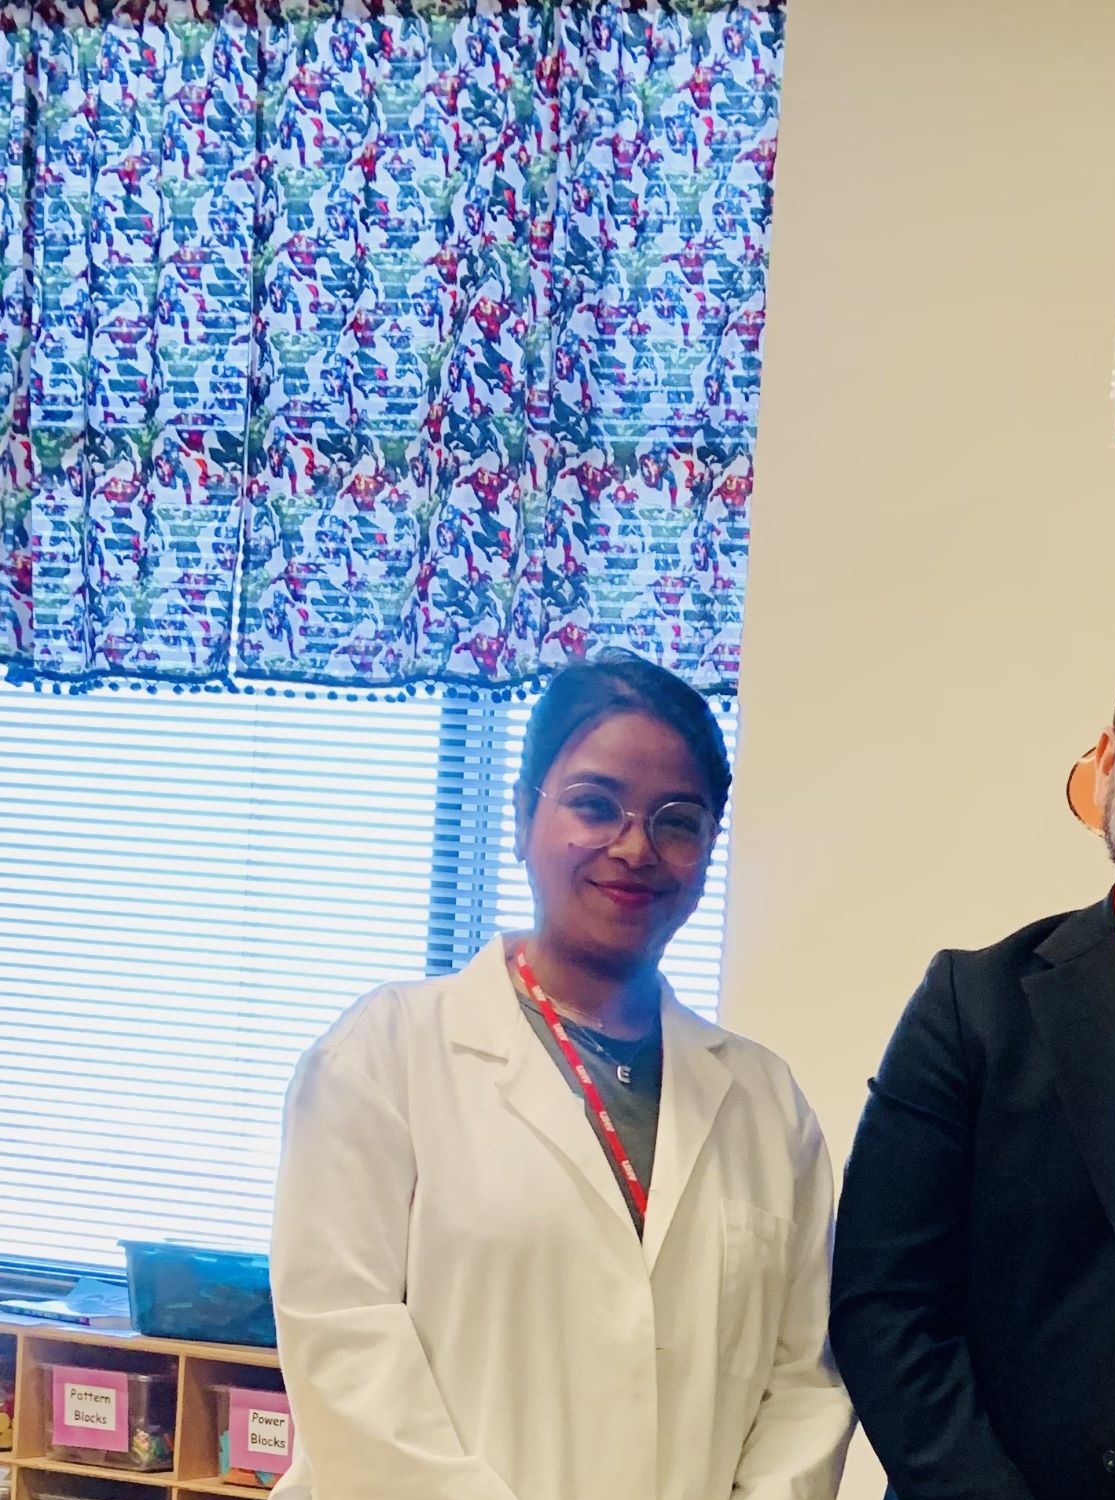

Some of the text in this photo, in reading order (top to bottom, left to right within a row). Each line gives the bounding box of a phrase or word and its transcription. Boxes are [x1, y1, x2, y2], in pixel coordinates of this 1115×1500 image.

[71, 1388, 111, 1404] Pattern
[75, 1410, 107, 1424] Blocks
[252, 1412, 286, 1426] Power
[251, 1433, 286, 1448] Blocks
